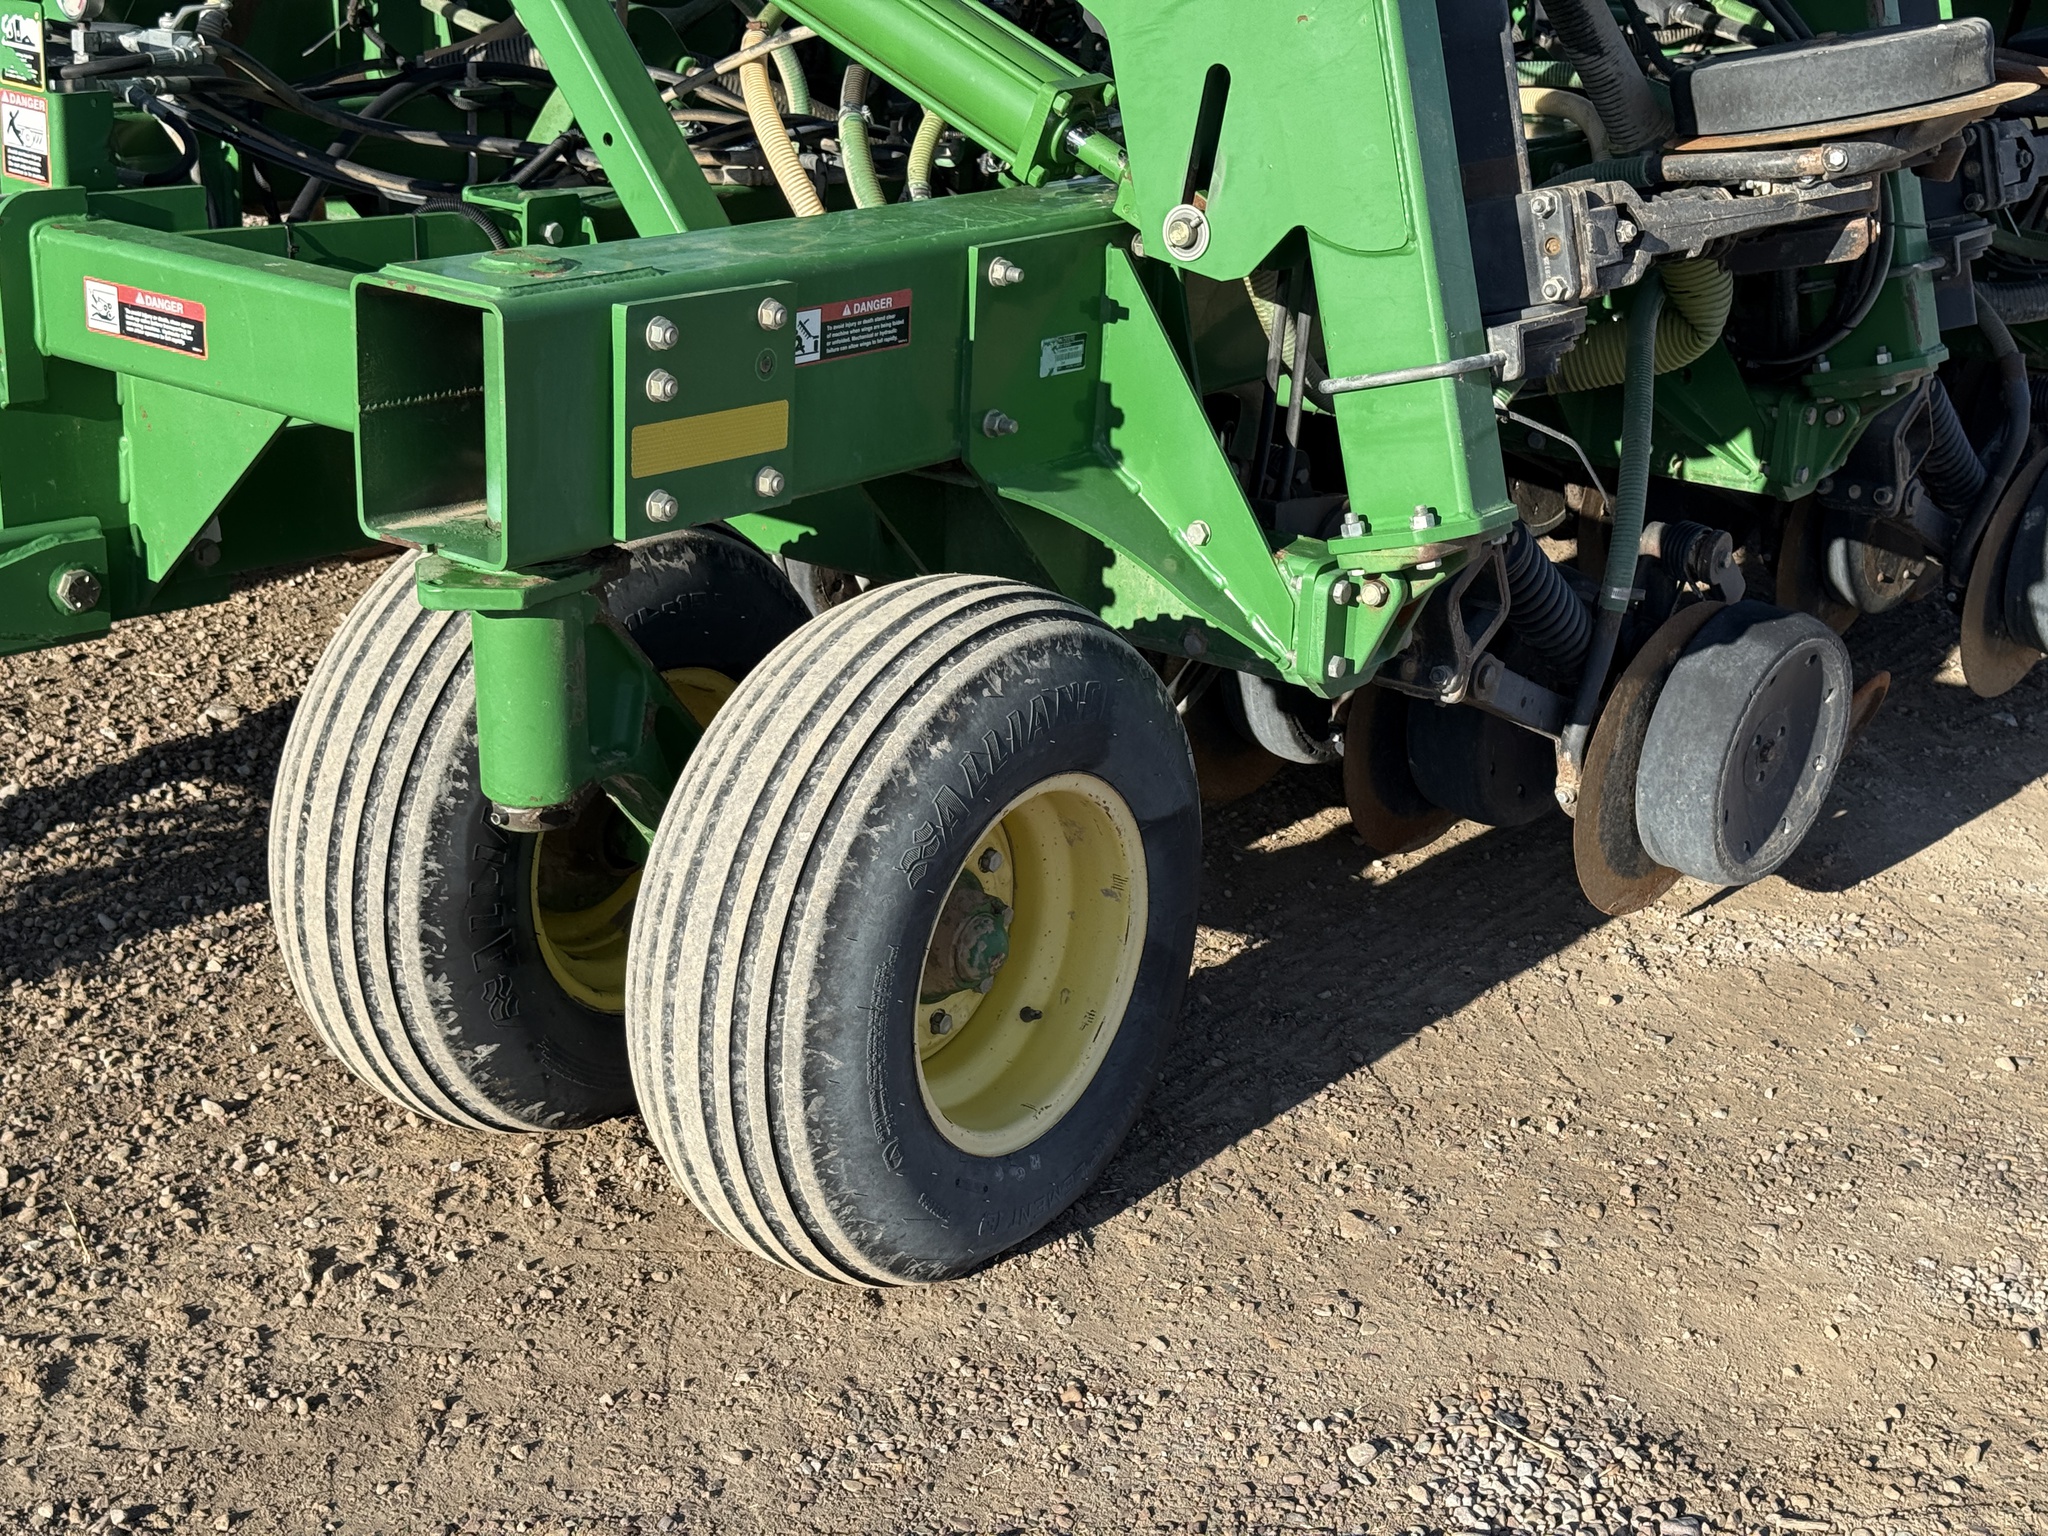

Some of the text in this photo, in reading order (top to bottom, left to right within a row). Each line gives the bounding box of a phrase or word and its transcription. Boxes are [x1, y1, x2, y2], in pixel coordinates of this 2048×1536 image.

[9, 93, 46, 112] DANGER
[145, 294, 184, 315] DANGER
[853, 297, 893, 315] DANGER
[1006, 1127, 1117, 1229] IMPLEMENT
